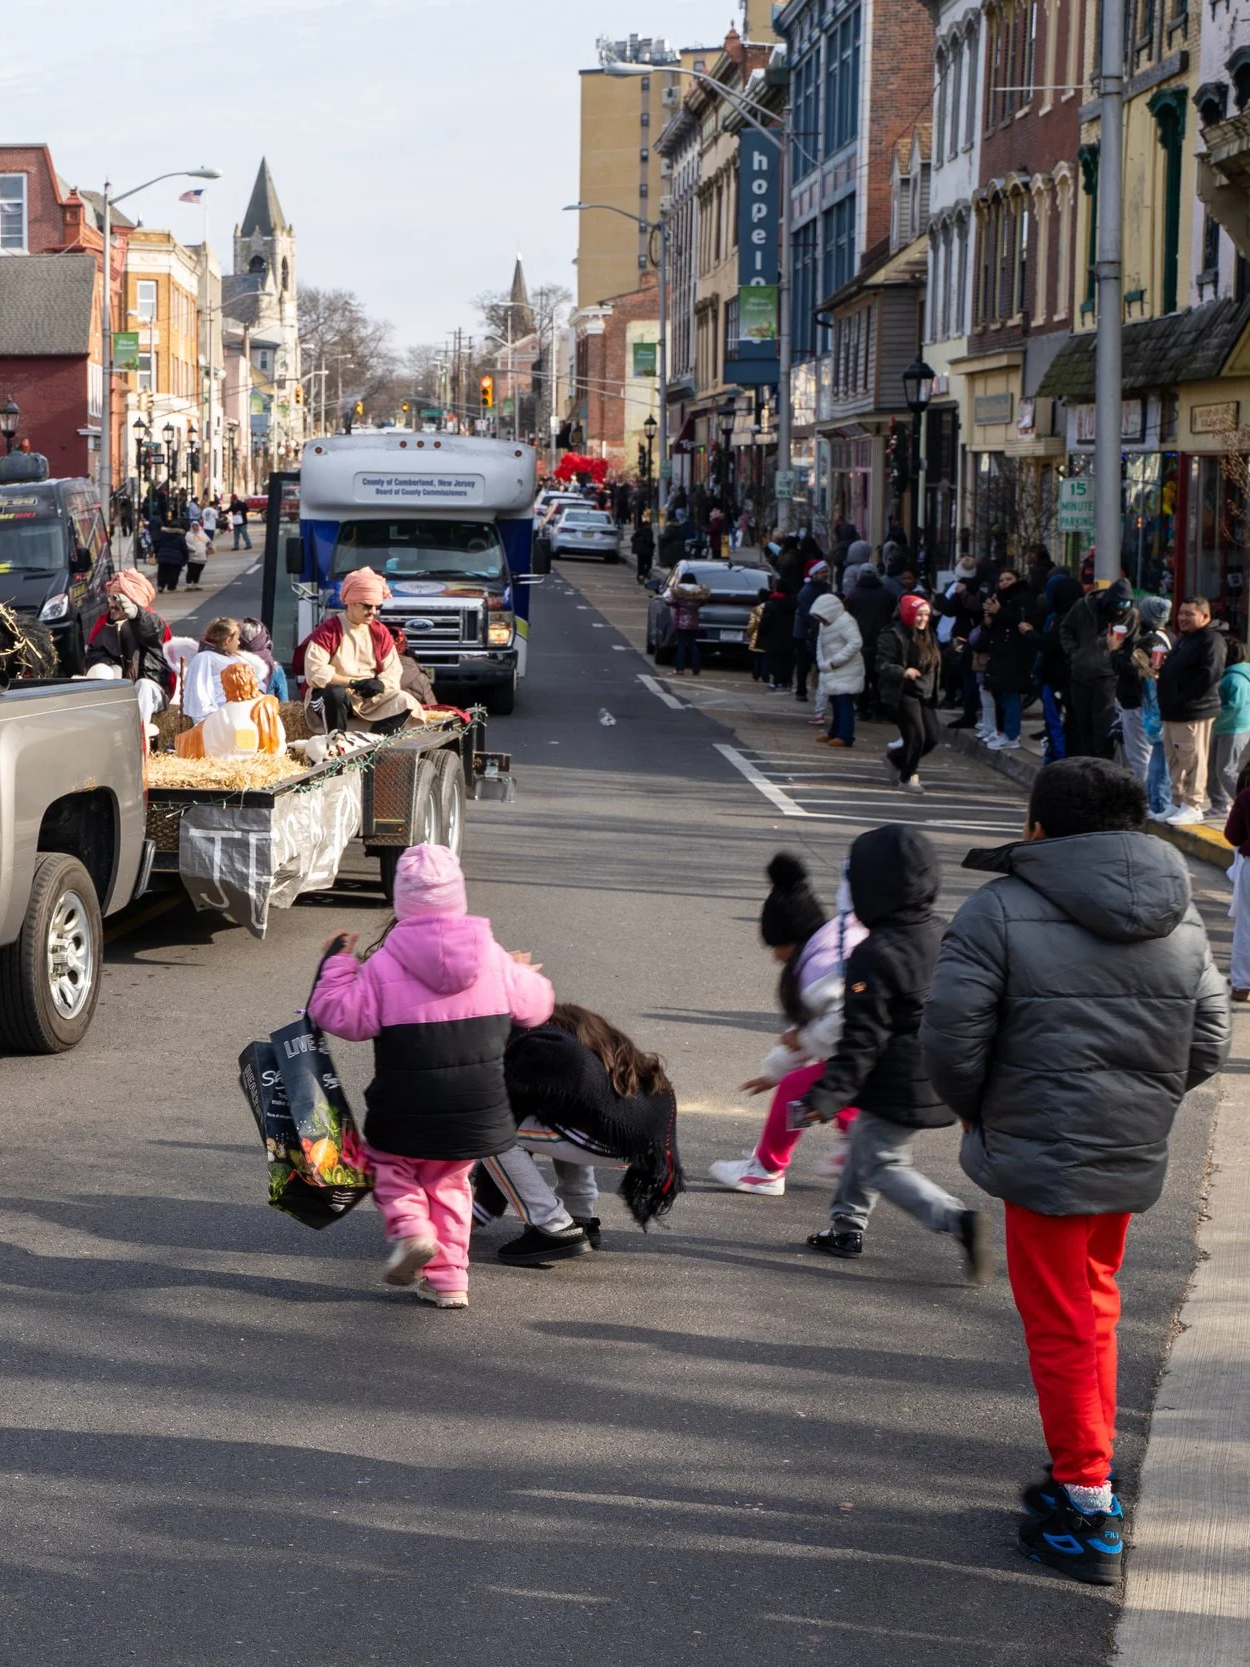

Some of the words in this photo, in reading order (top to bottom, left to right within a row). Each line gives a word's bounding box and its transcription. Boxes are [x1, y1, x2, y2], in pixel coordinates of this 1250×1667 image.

[362, 477, 385, 488] County
[386, 477, 393, 486] of
[393, 478, 436, 488] Cumberland,
[437, 478, 452, 487] New
[453, 479, 476, 489] Jersey
[1070, 481, 1087, 496] 15
[375, 487, 393, 495] Board
[394, 487, 400, 495] of
[401, 488, 421, 497] County
[422, 488, 467, 497] Commissioners
[284, 1033, 317, 1058] LIVE
